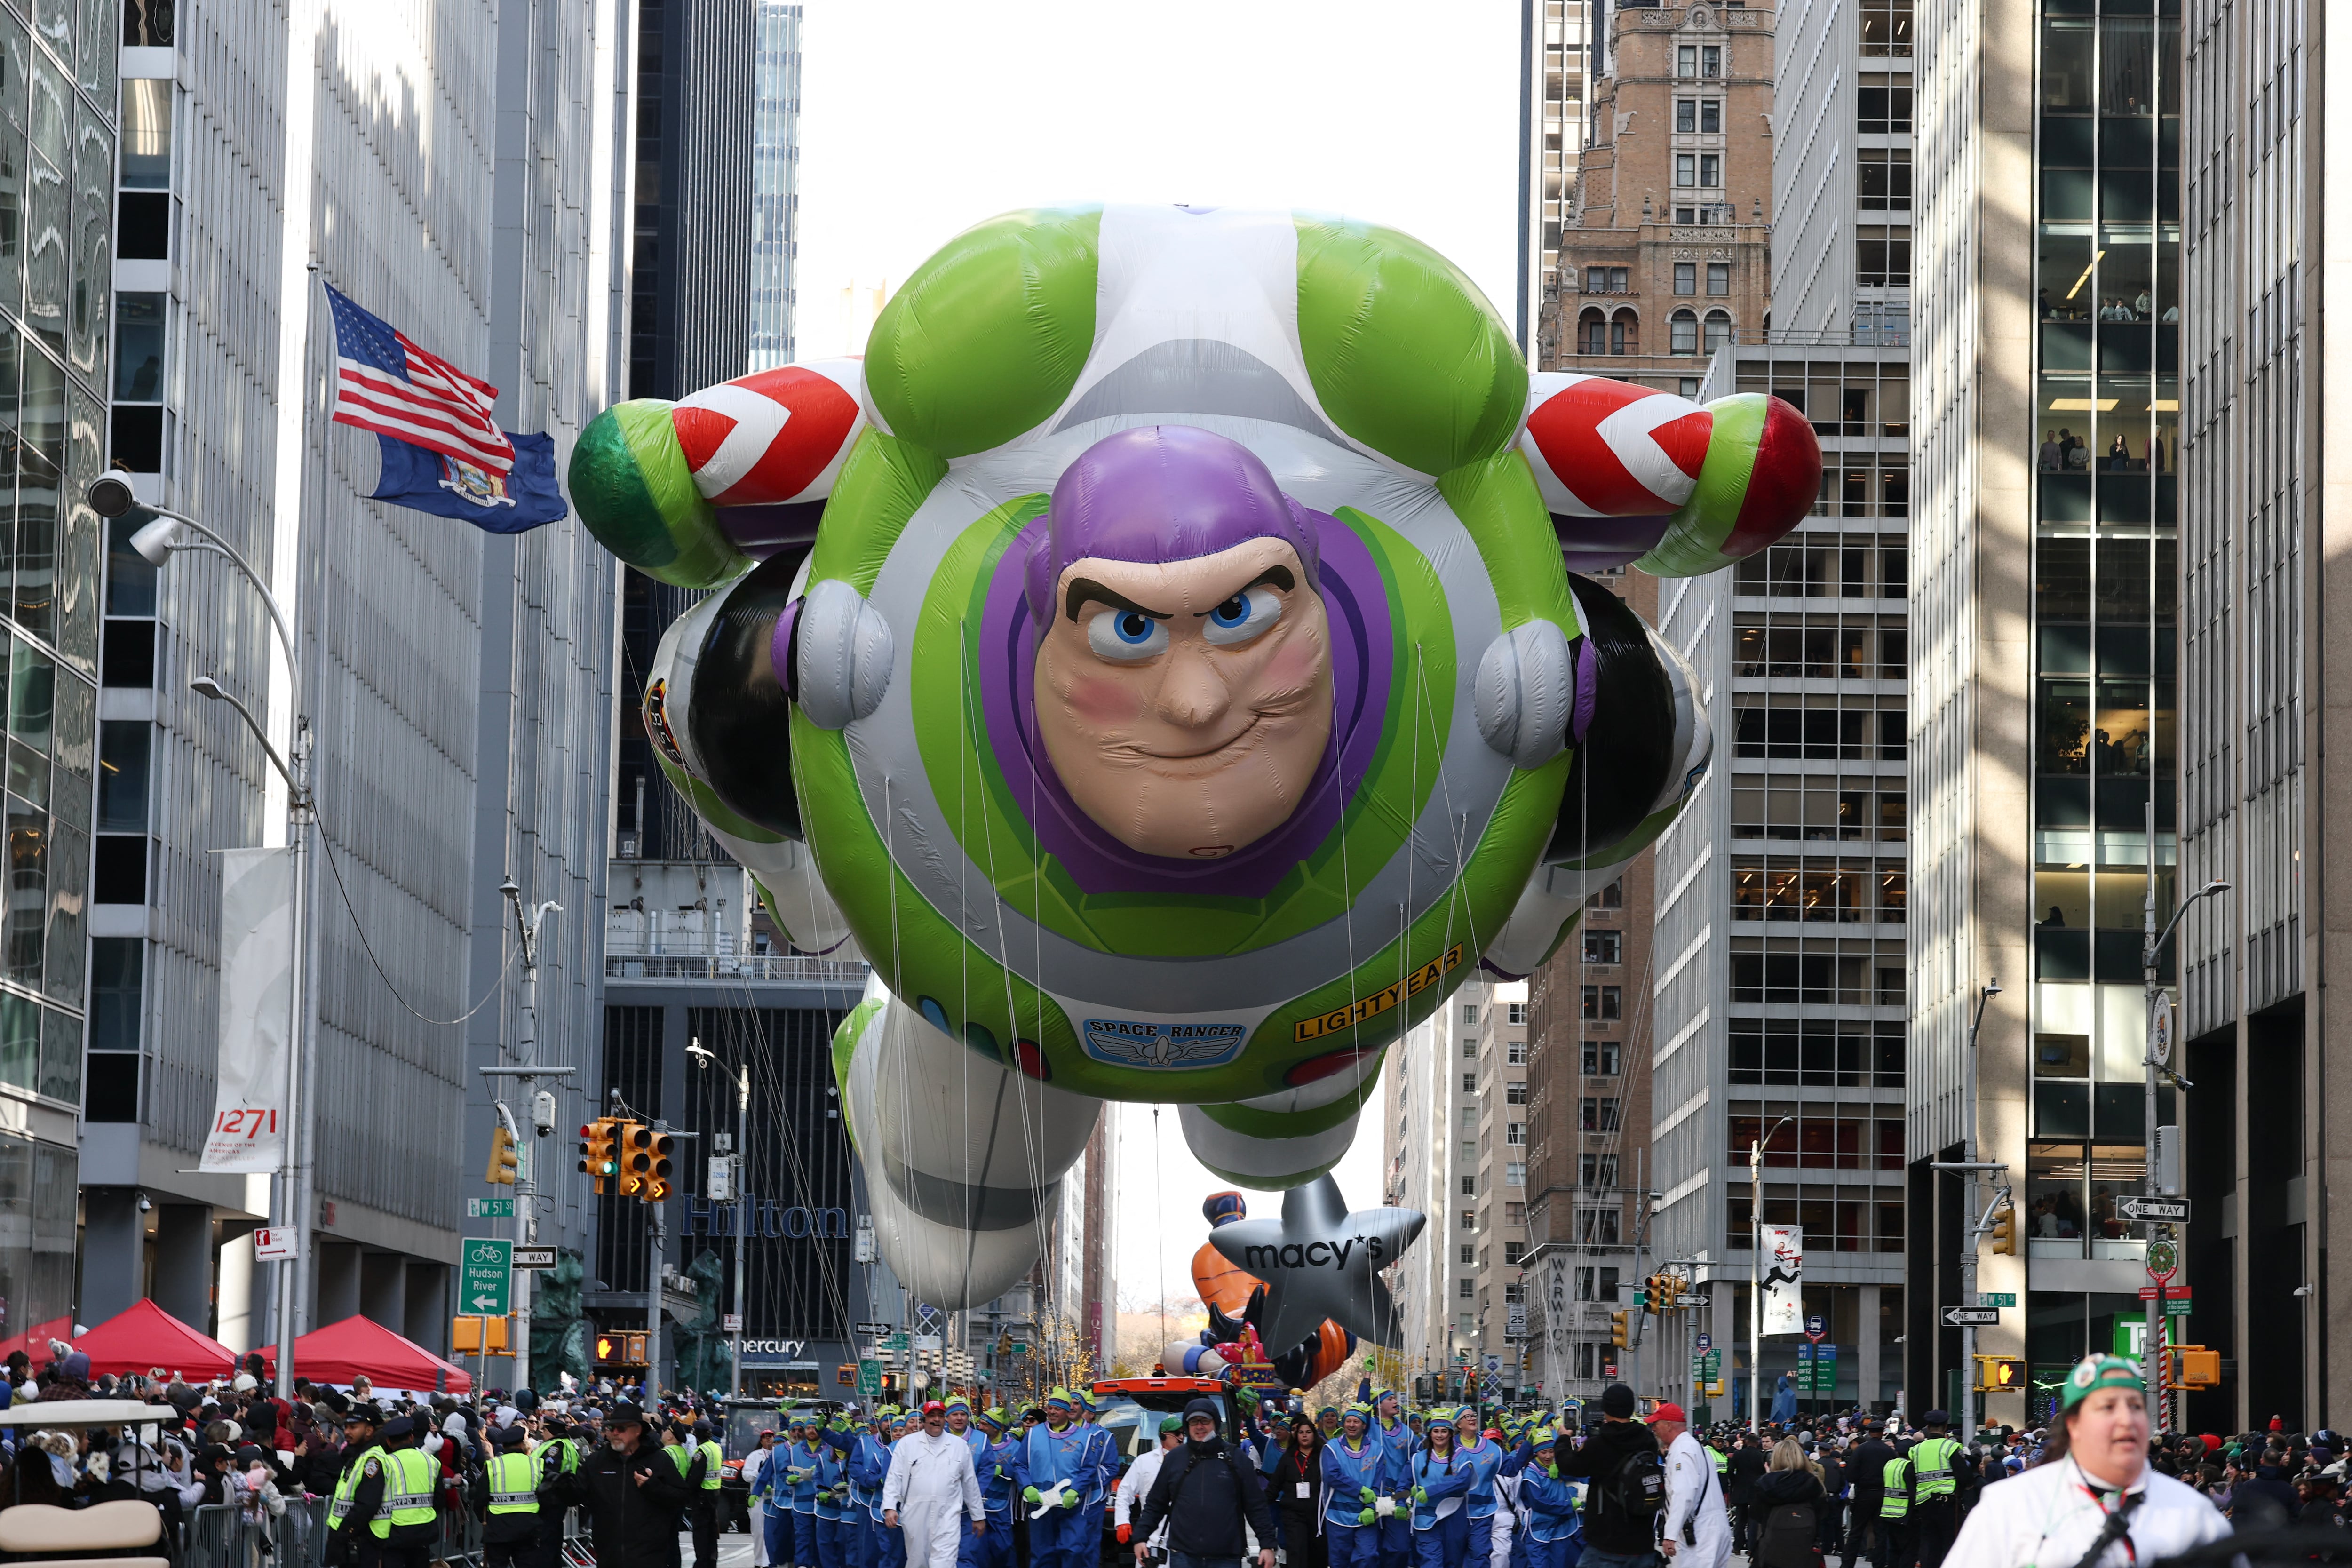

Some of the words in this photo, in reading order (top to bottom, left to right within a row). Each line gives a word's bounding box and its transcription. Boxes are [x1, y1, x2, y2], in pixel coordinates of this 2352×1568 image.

[459, 490, 490, 506] EXCELSIOR
[1299, 949, 1459, 1039] LIGHTYEAR
[1089, 1021, 1158, 1036] SPACE
[1170, 1026, 1244, 1037] RANGER
[215, 1109, 276, 1139] 1271
[481, 1201, 489, 1214] W
[493, 1201, 502, 1214] 51
[2128, 1204, 2148, 1214] ONE
[2159, 1205, 2180, 1215] WAY
[680, 1193, 849, 1239] Hilton
[529, 1253, 549, 1262] WAY
[469, 1267, 503, 1279] Hudson
[2148, 1268, 2160, 1280] Happy
[473, 1281, 497, 1291] River
[1988, 1295, 1995, 1305] W
[1998, 1295, 2006, 1305] 51
[1551, 1258, 1566, 1355] WARWICK
[1510, 1315, 1524, 1324] 25
